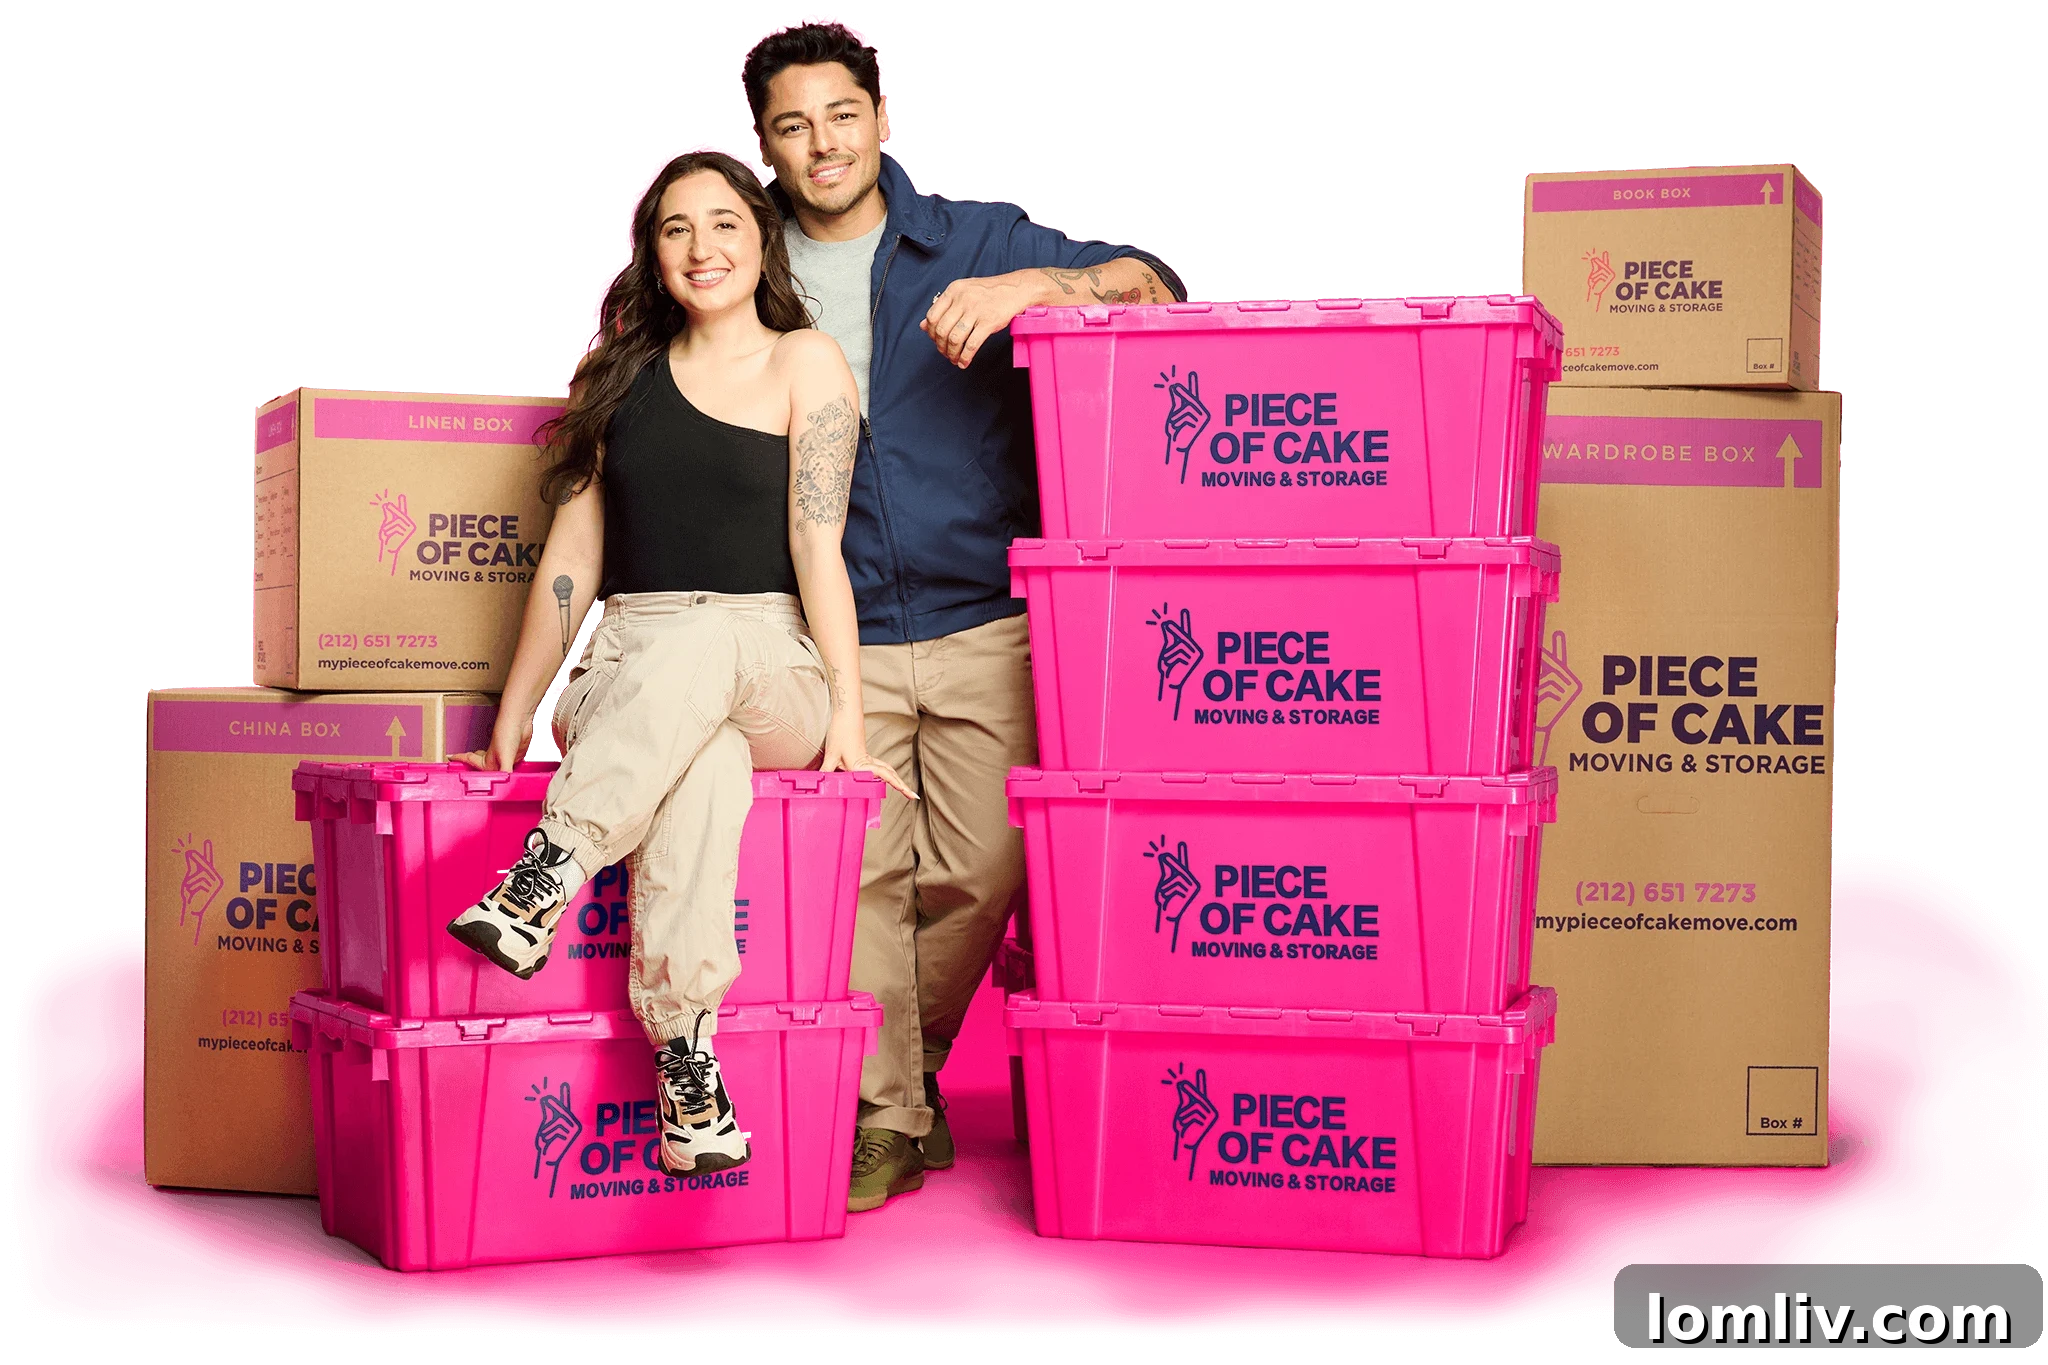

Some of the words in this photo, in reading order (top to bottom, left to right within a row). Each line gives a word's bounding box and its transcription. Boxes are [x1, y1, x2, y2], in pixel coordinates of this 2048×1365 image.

[1613, 188, 1655, 201] BOOK
[1660, 187, 1690, 199] BOX
[1625, 261, 1693, 279] PIECE
[1616, 282, 1648, 300] OF
[1655, 280, 1723, 300] CAKE
[1609, 303, 1656, 314] MOVING
[1658, 303, 1666, 313] &
[1669, 302, 1723, 313] STORAGE
[1564, 347, 1586, 357] 651
[1589, 345, 1620, 357] 7273
[1562, 362, 1659, 372] ceofcakemove.com
[1226, 393, 1337, 426] PIECE
[409, 415, 466, 431] LINEN
[473, 417, 513, 432] BOX
[1210, 432, 1265, 464] OF
[1274, 430, 1389, 464] CAKE
[1543, 443, 1692, 461] WARDROBE
[1704, 446, 1754, 462] BOX
[1201, 471, 1276, 488] MOVING
[1279, 471, 1293, 487] &
[1296, 470, 1388, 487] STORAGE
[429, 514, 518, 539] PIECE
[417, 541, 461, 564] OF
[409, 570, 470, 583] MOVING
[473, 571, 484, 583] &
[487, 572, 535, 583] STORA
[317, 633, 359, 650] (212)
[363, 634, 391, 648] 651
[396, 634, 439, 649] 7273
[1218, 631, 1329, 664] PIECE
[318, 658, 490, 671] mypieceofcakemove.com
[1203, 670, 1258, 702] OF
[1266, 670, 1381, 702] CAKE
[1603, 655, 1757, 697] PIECE
[1194, 708, 1269, 725] MOVING
[1271, 709, 1286, 725] &
[1288, 709, 1380, 725] STORAGE
[1582, 702, 1658, 743] OF
[1672, 703, 1823, 745] CAKE
[228, 720, 291, 736] CHINA
[300, 721, 341, 738] BOX
[1570, 753, 1672, 772] MOVING
[1682, 754, 1697, 772] &
[1706, 755, 1825, 774] STORAGE
[240, 862, 317, 896] PIEC
[1215, 865, 1327, 898] PIECE
[1576, 882, 1634, 906] (212)
[1644, 883, 1684, 902] 651
[1695, 883, 1756, 902] 7273
[226, 898, 277, 929] OF
[577, 902, 628, 936] OF
[1200, 902, 1255, 934] OF
[1264, 904, 1379, 937] CAKE
[1535, 913, 1798, 932] mypieceofcakemove.com
[218, 936, 287, 952] MOVING
[293, 939, 304, 953] &
[1192, 942, 1266, 958] MOVING
[1269, 942, 1284, 959] &
[1287, 944, 1377, 960] STORAGE
[222, 1009, 262, 1029] (212)
[268, 1012, 289, 1028] 65
[198, 1036, 307, 1054] mypieceofcak
[596, 1101, 657, 1137] PIE
[1234, 1094, 1346, 1130] PIECE
[1760, 1117, 1788, 1129] Box
[1792, 1117, 1803, 1129] #
[580, 1140, 636, 1175] OF
[1218, 1131, 1273, 1164] OF
[1282, 1134, 1396, 1169] CAKE
[570, 1180, 644, 1199] MOVING
[647, 1178, 661, 1194] &
[664, 1171, 749, 1192] STORAGE
[1210, 1170, 1284, 1188] MOVING
[1287, 1173, 1301, 1190] &
[1305, 1175, 1395, 1192] STORAGE
